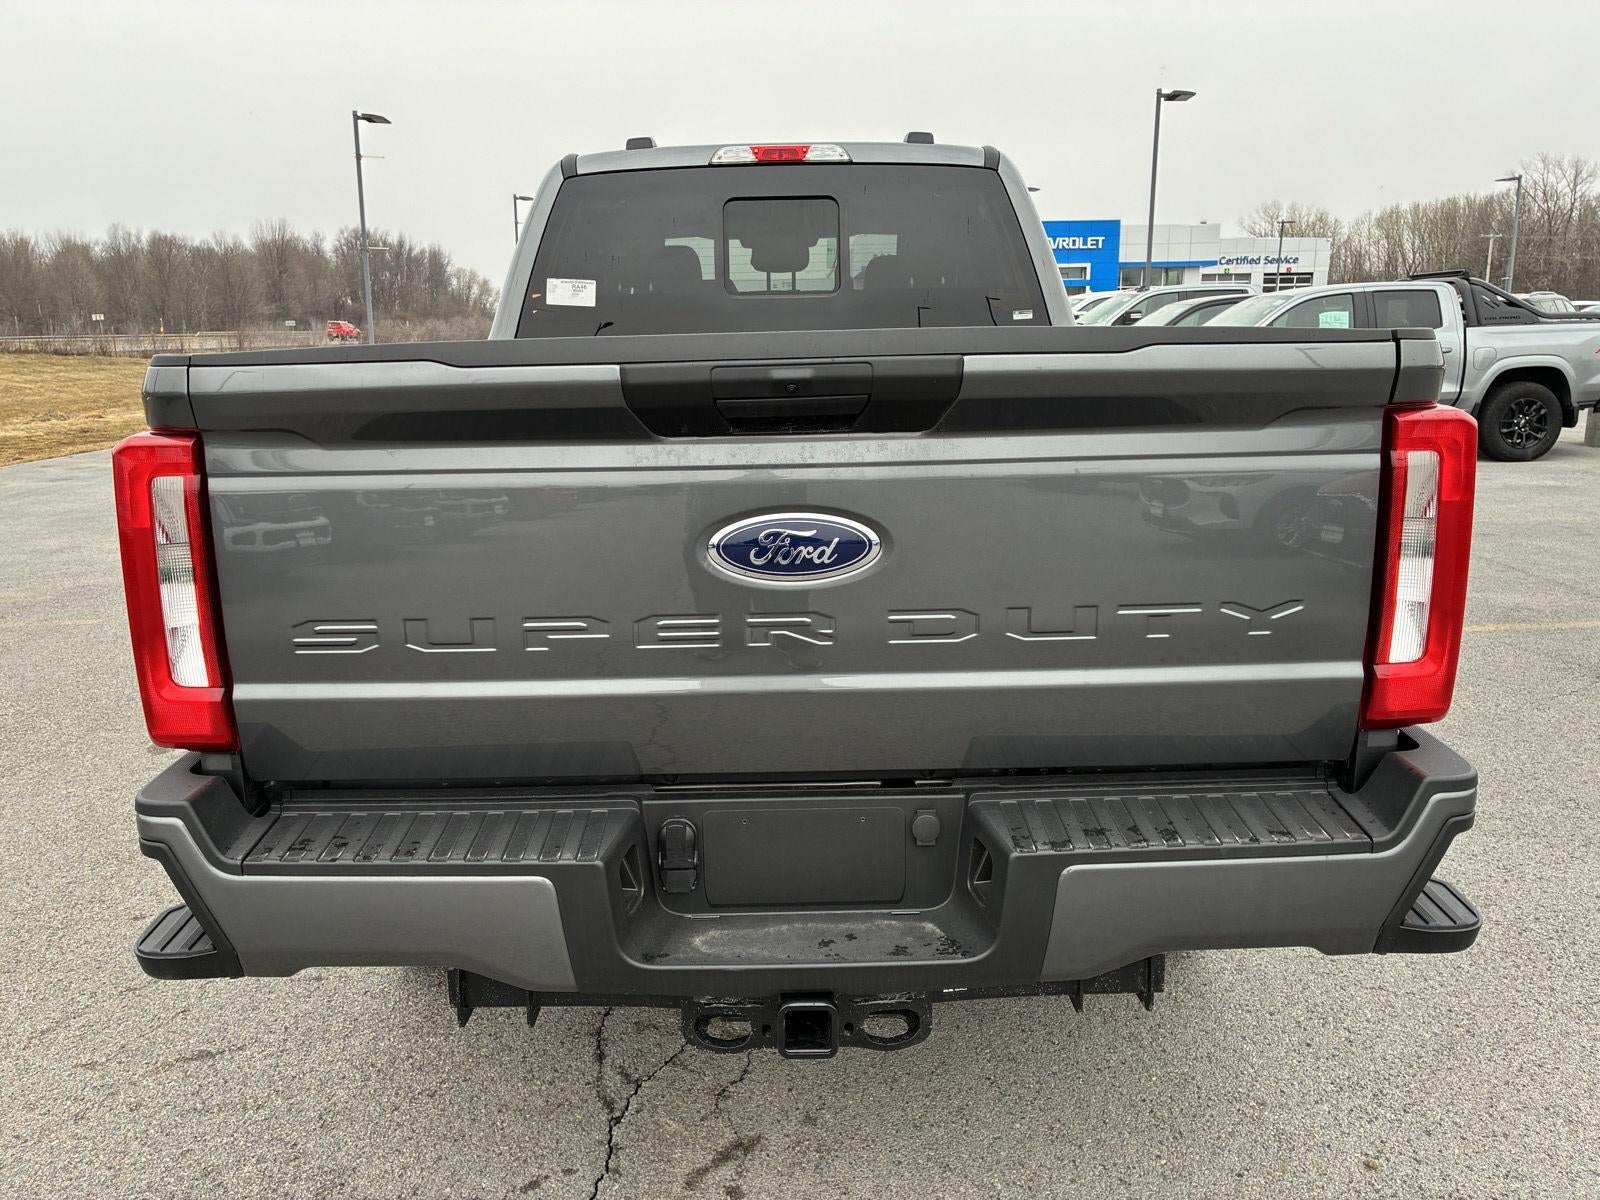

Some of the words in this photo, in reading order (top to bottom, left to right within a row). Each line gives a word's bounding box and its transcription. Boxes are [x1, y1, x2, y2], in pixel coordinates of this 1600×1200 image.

[1219, 255, 1262, 266] Certified
[1264, 254, 1300, 265] Service
[749, 528, 840, 566] Ford
[291, 610, 837, 653] SUPER
[887, 599, 1304, 643] DUTY
